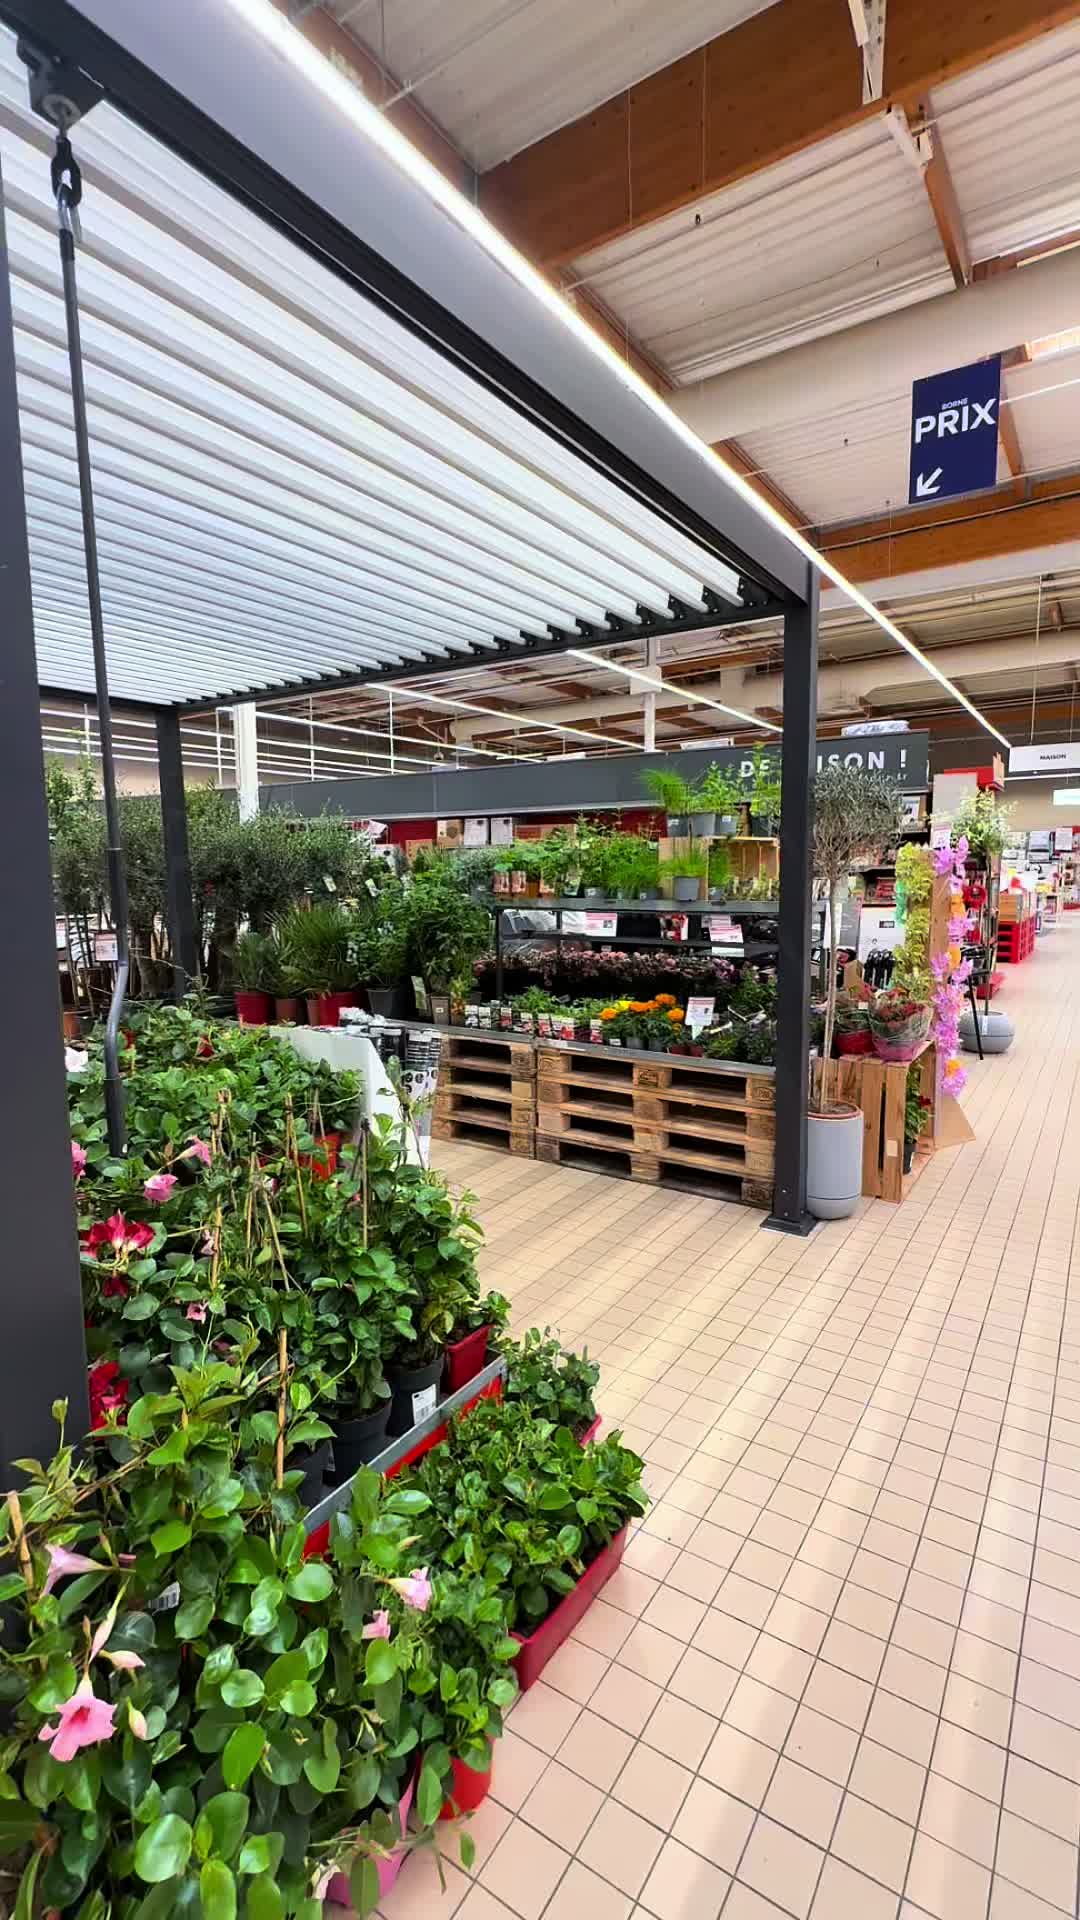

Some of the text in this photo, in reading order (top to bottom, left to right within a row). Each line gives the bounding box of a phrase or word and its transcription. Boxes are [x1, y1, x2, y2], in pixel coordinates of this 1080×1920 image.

[941, 397, 968, 410] BORNE
[915, 398, 996, 443] PRIX
[817, 751, 884, 773] ISON
